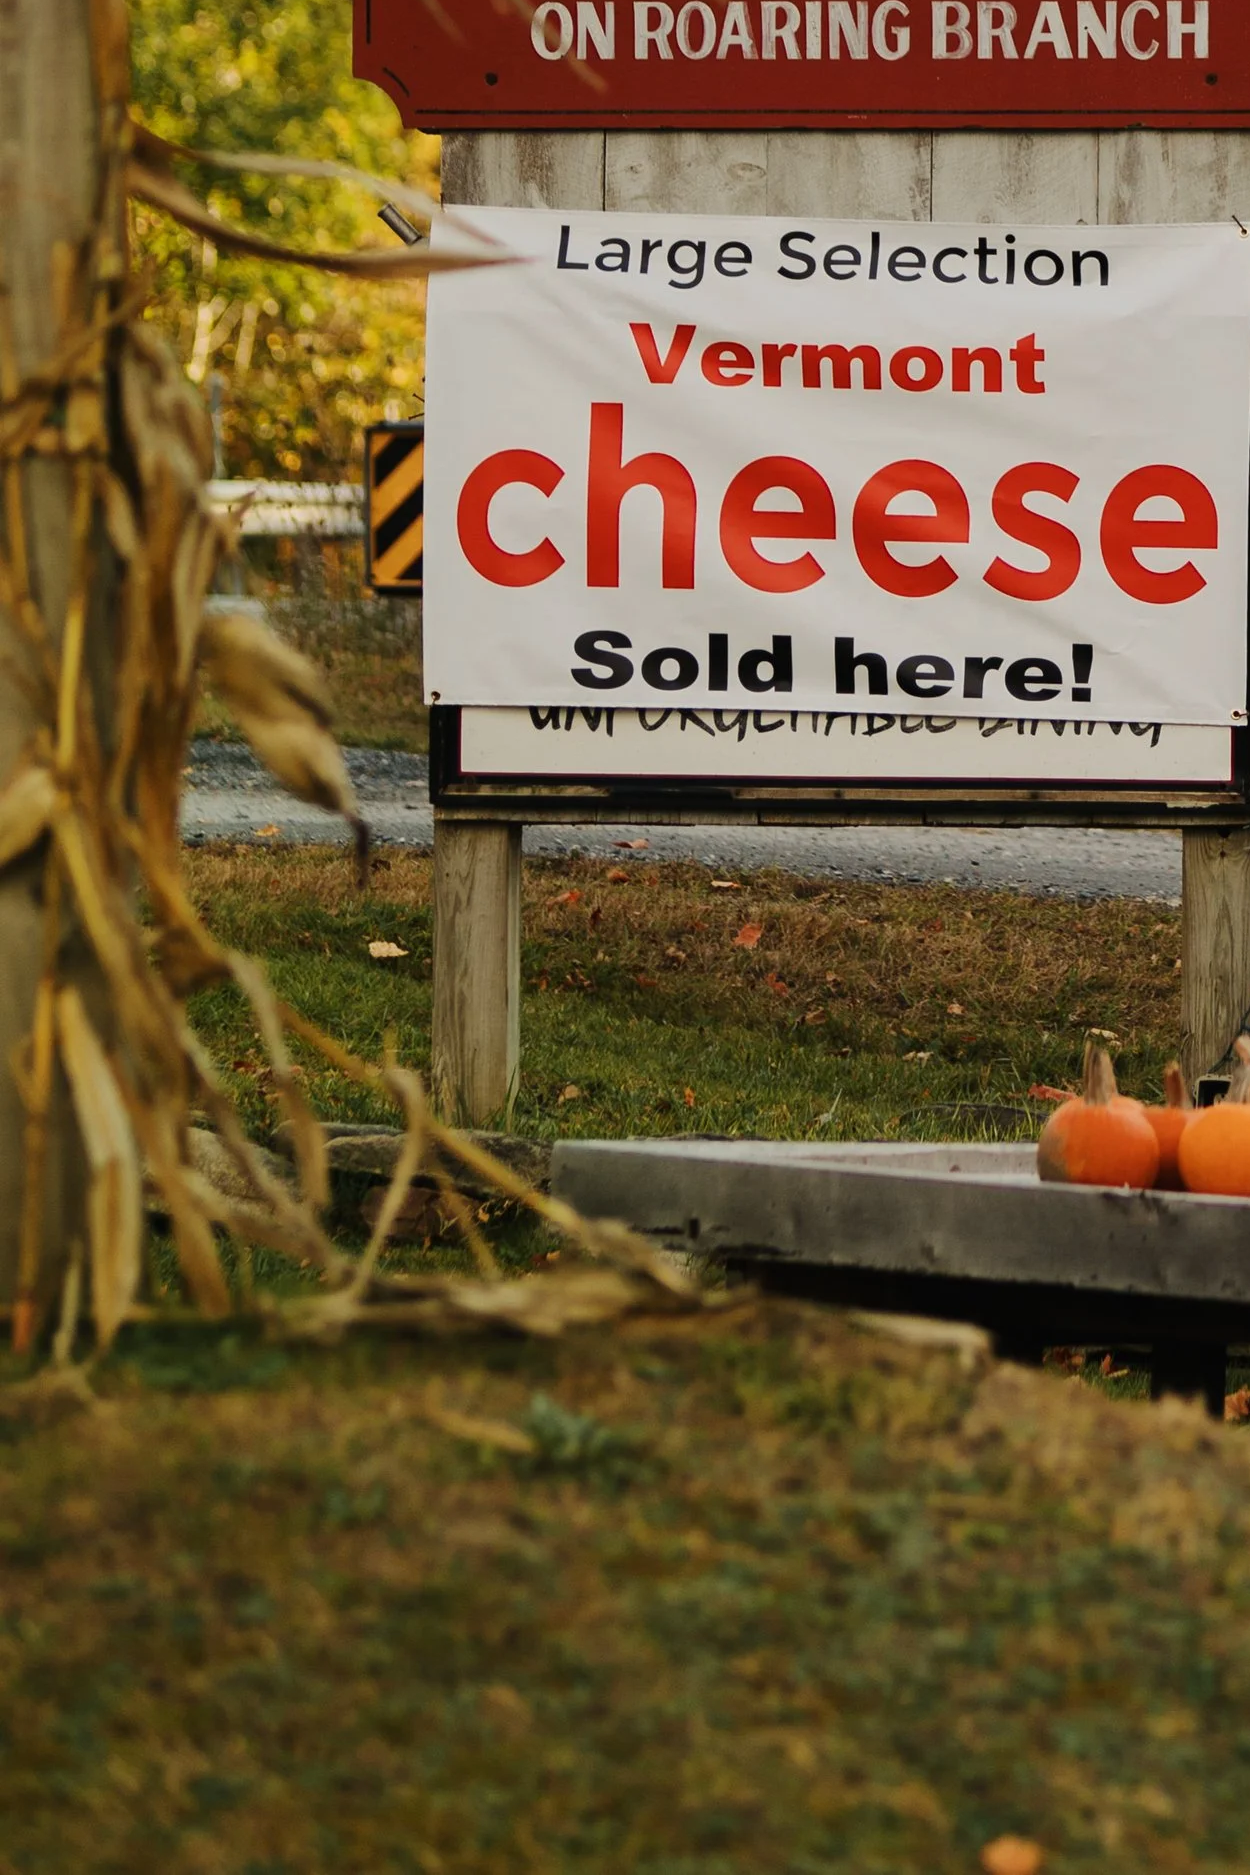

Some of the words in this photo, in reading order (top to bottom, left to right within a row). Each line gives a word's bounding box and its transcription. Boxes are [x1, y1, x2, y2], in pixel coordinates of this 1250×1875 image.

[530, 1, 615, 61] ON
[633, 0, 910, 61] ROARING
[931, 0, 1209, 61] BRANCH
[556, 224, 753, 290] Large
[777, 231, 1109, 287] Selection
[629, 321, 1046, 395] Vermont
[456, 401, 1219, 605] cheese
[570, 630, 794, 693] Sold
[834, 636, 1094, 703] here!
